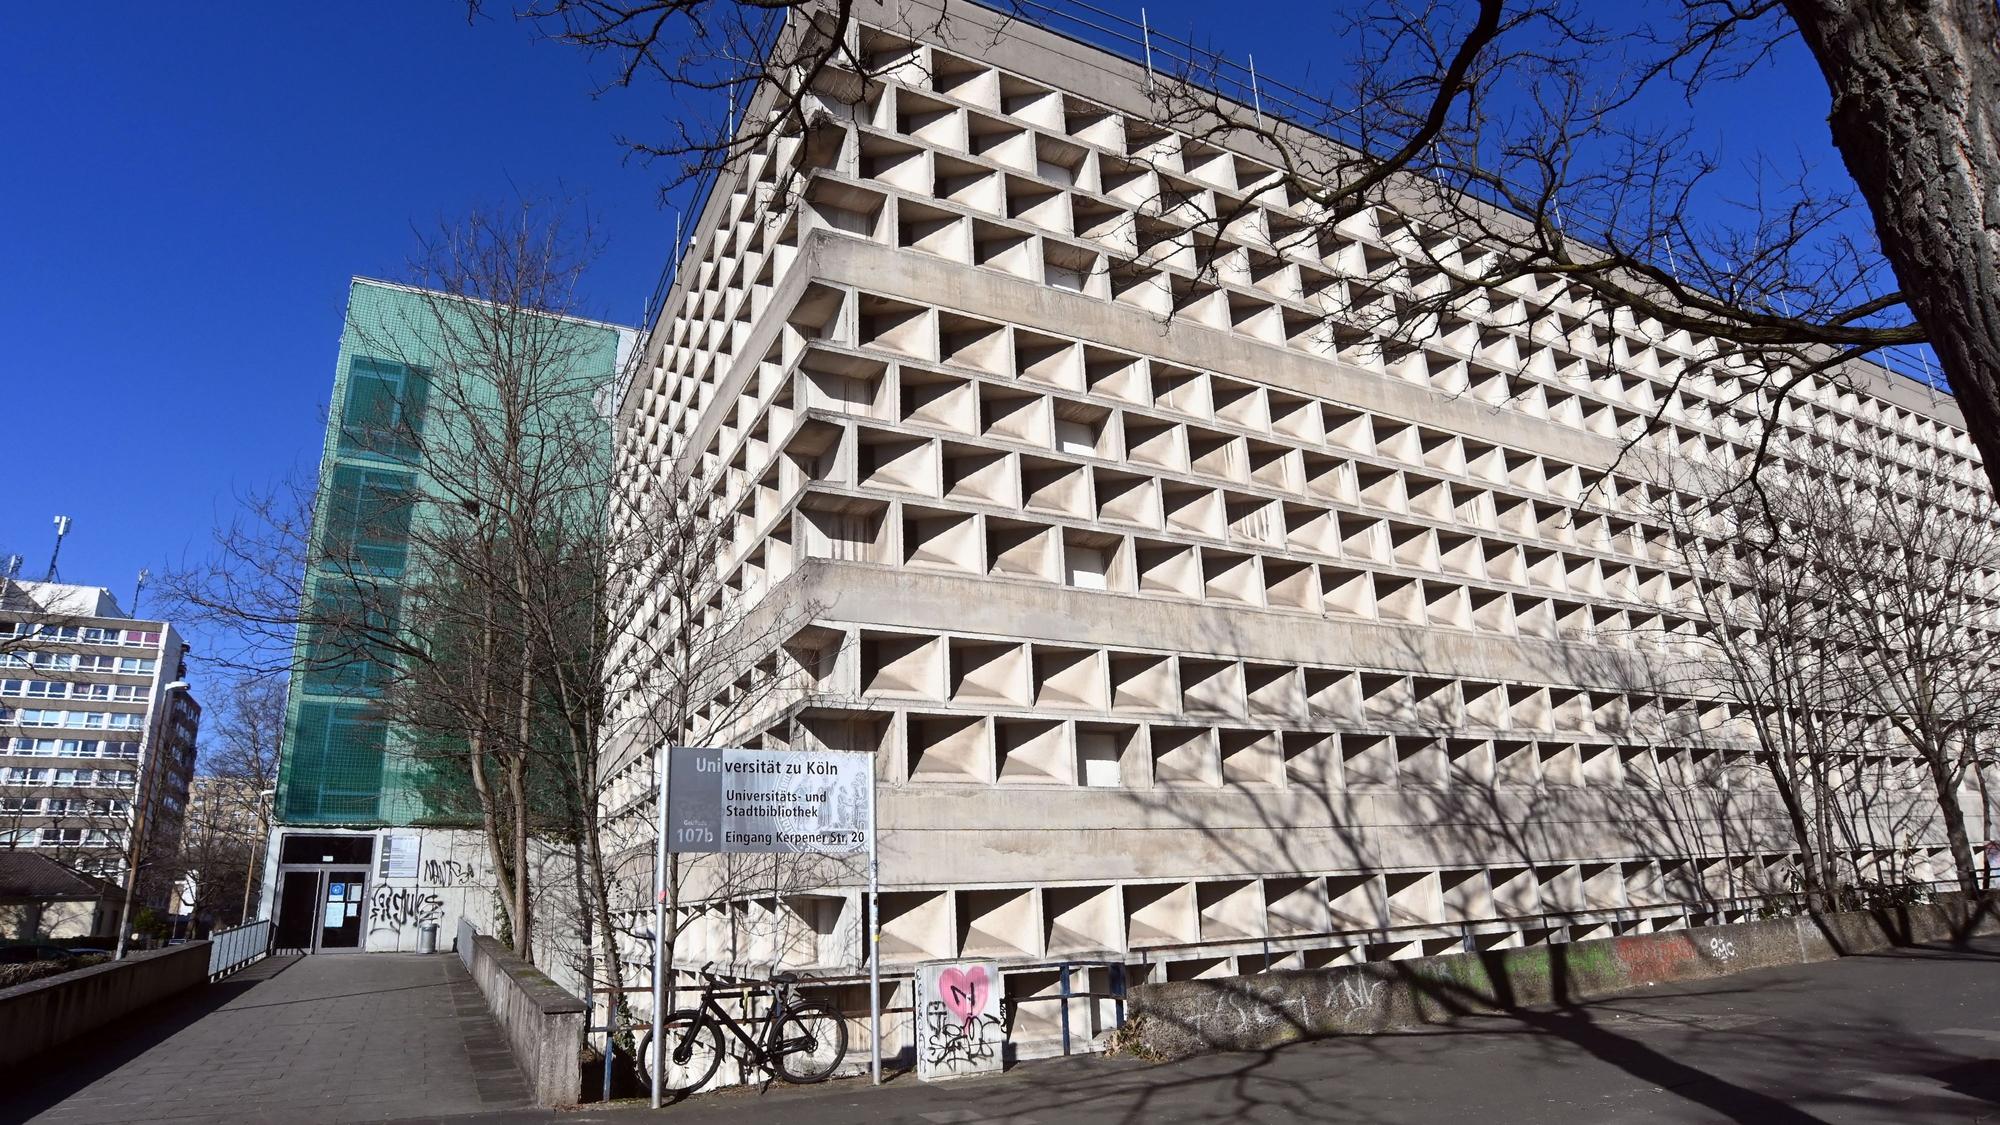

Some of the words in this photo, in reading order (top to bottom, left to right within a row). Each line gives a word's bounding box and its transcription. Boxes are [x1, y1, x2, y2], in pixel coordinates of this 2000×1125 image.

[786, 763, 802, 775] zu
[807, 761, 838, 775] Köln
[726, 789, 802, 802] Universitäts-
[805, 790, 827, 802] und
[726, 805, 818, 818] Stadtbibliothek
[677, 828, 713, 843] 107b
[725, 831, 772, 845] Eingang
[776, 831, 827, 846] Kerpener
[830, 832, 848, 844] Str.
[851, 831, 866, 843] 20
